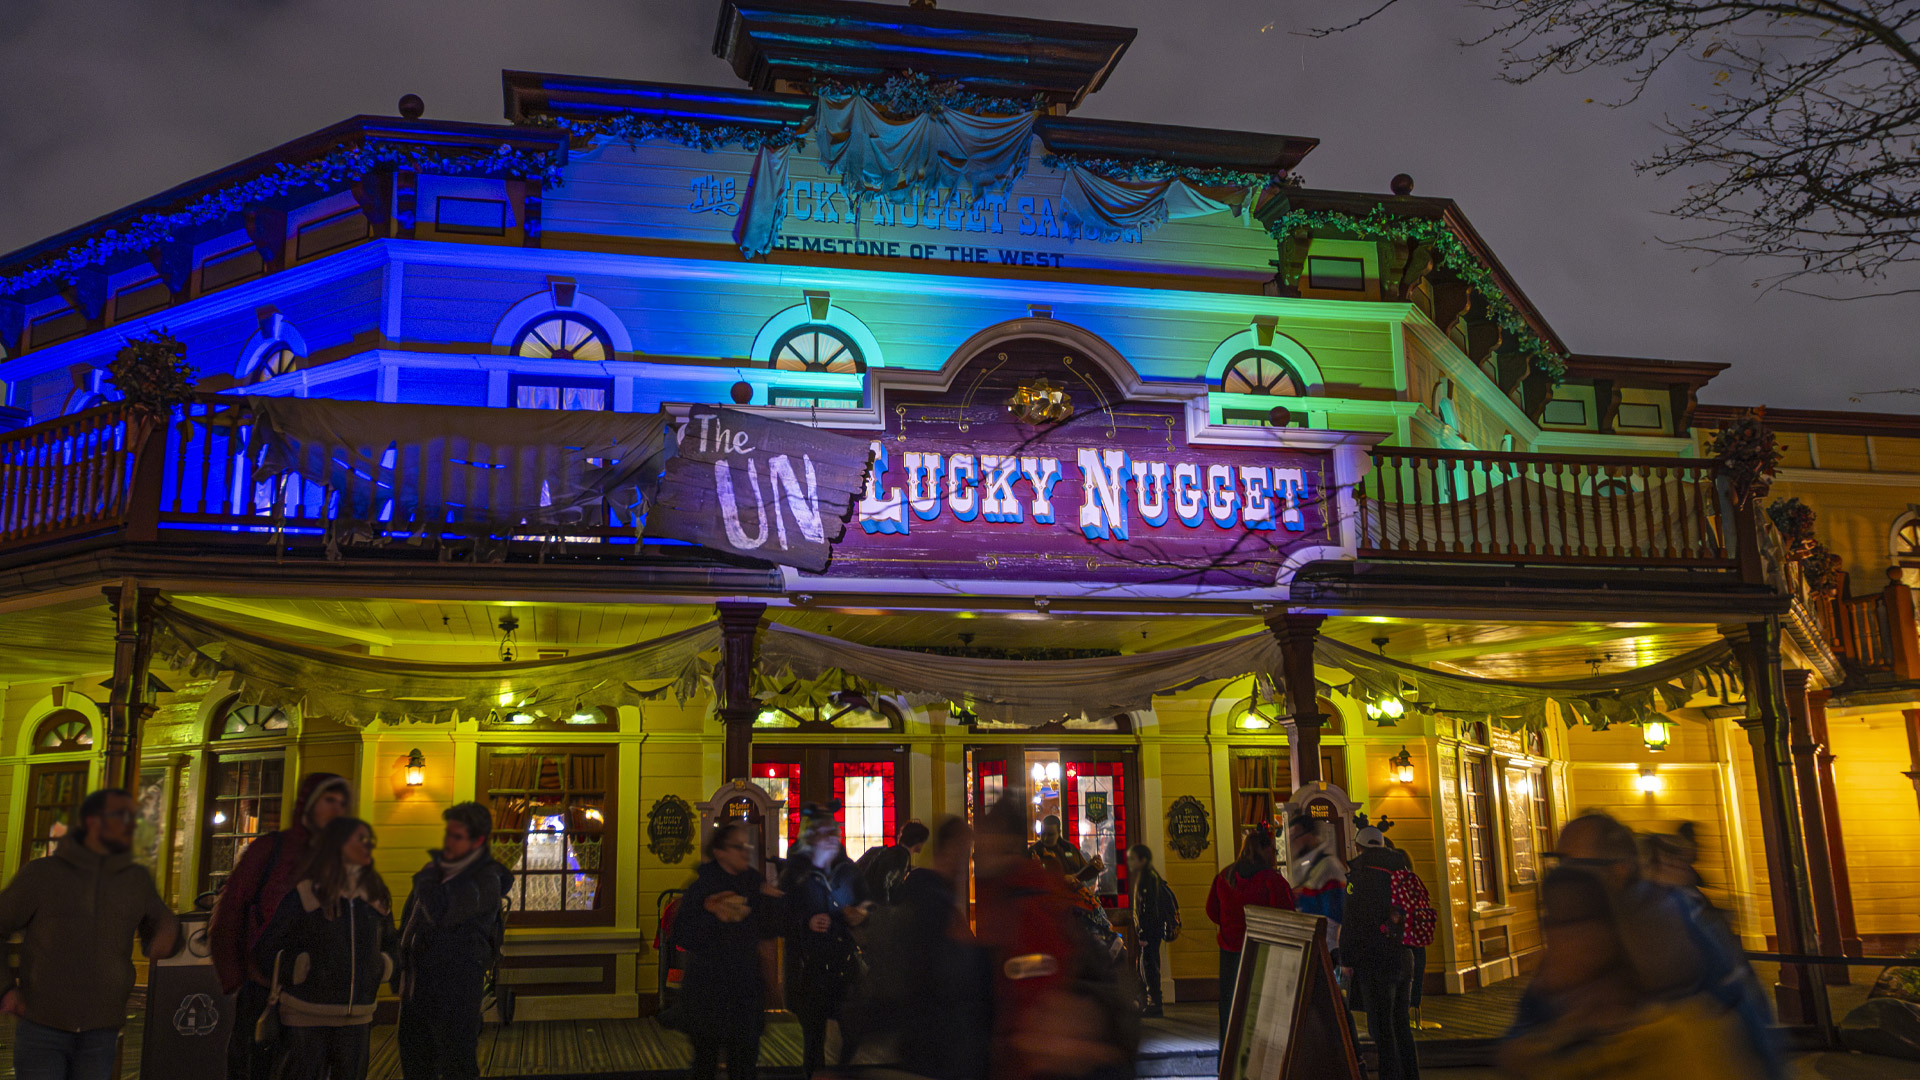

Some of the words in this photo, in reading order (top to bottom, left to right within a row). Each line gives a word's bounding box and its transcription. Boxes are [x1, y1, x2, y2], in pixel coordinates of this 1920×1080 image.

[688, 174, 738, 212] The
[785, 180, 857, 225] CKY
[871, 187, 1008, 235] NUGGET
[775, 236, 901, 258] GEMSTONE
[910, 243, 938, 260] OF
[944, 246, 989, 264] THE
[998, 249, 1064, 269] WEST
[694, 413, 756, 454] The
[714, 453, 825, 551] UN
[859, 440, 1062, 535] LUCKY
[1077, 447, 1308, 541] NUGGET
